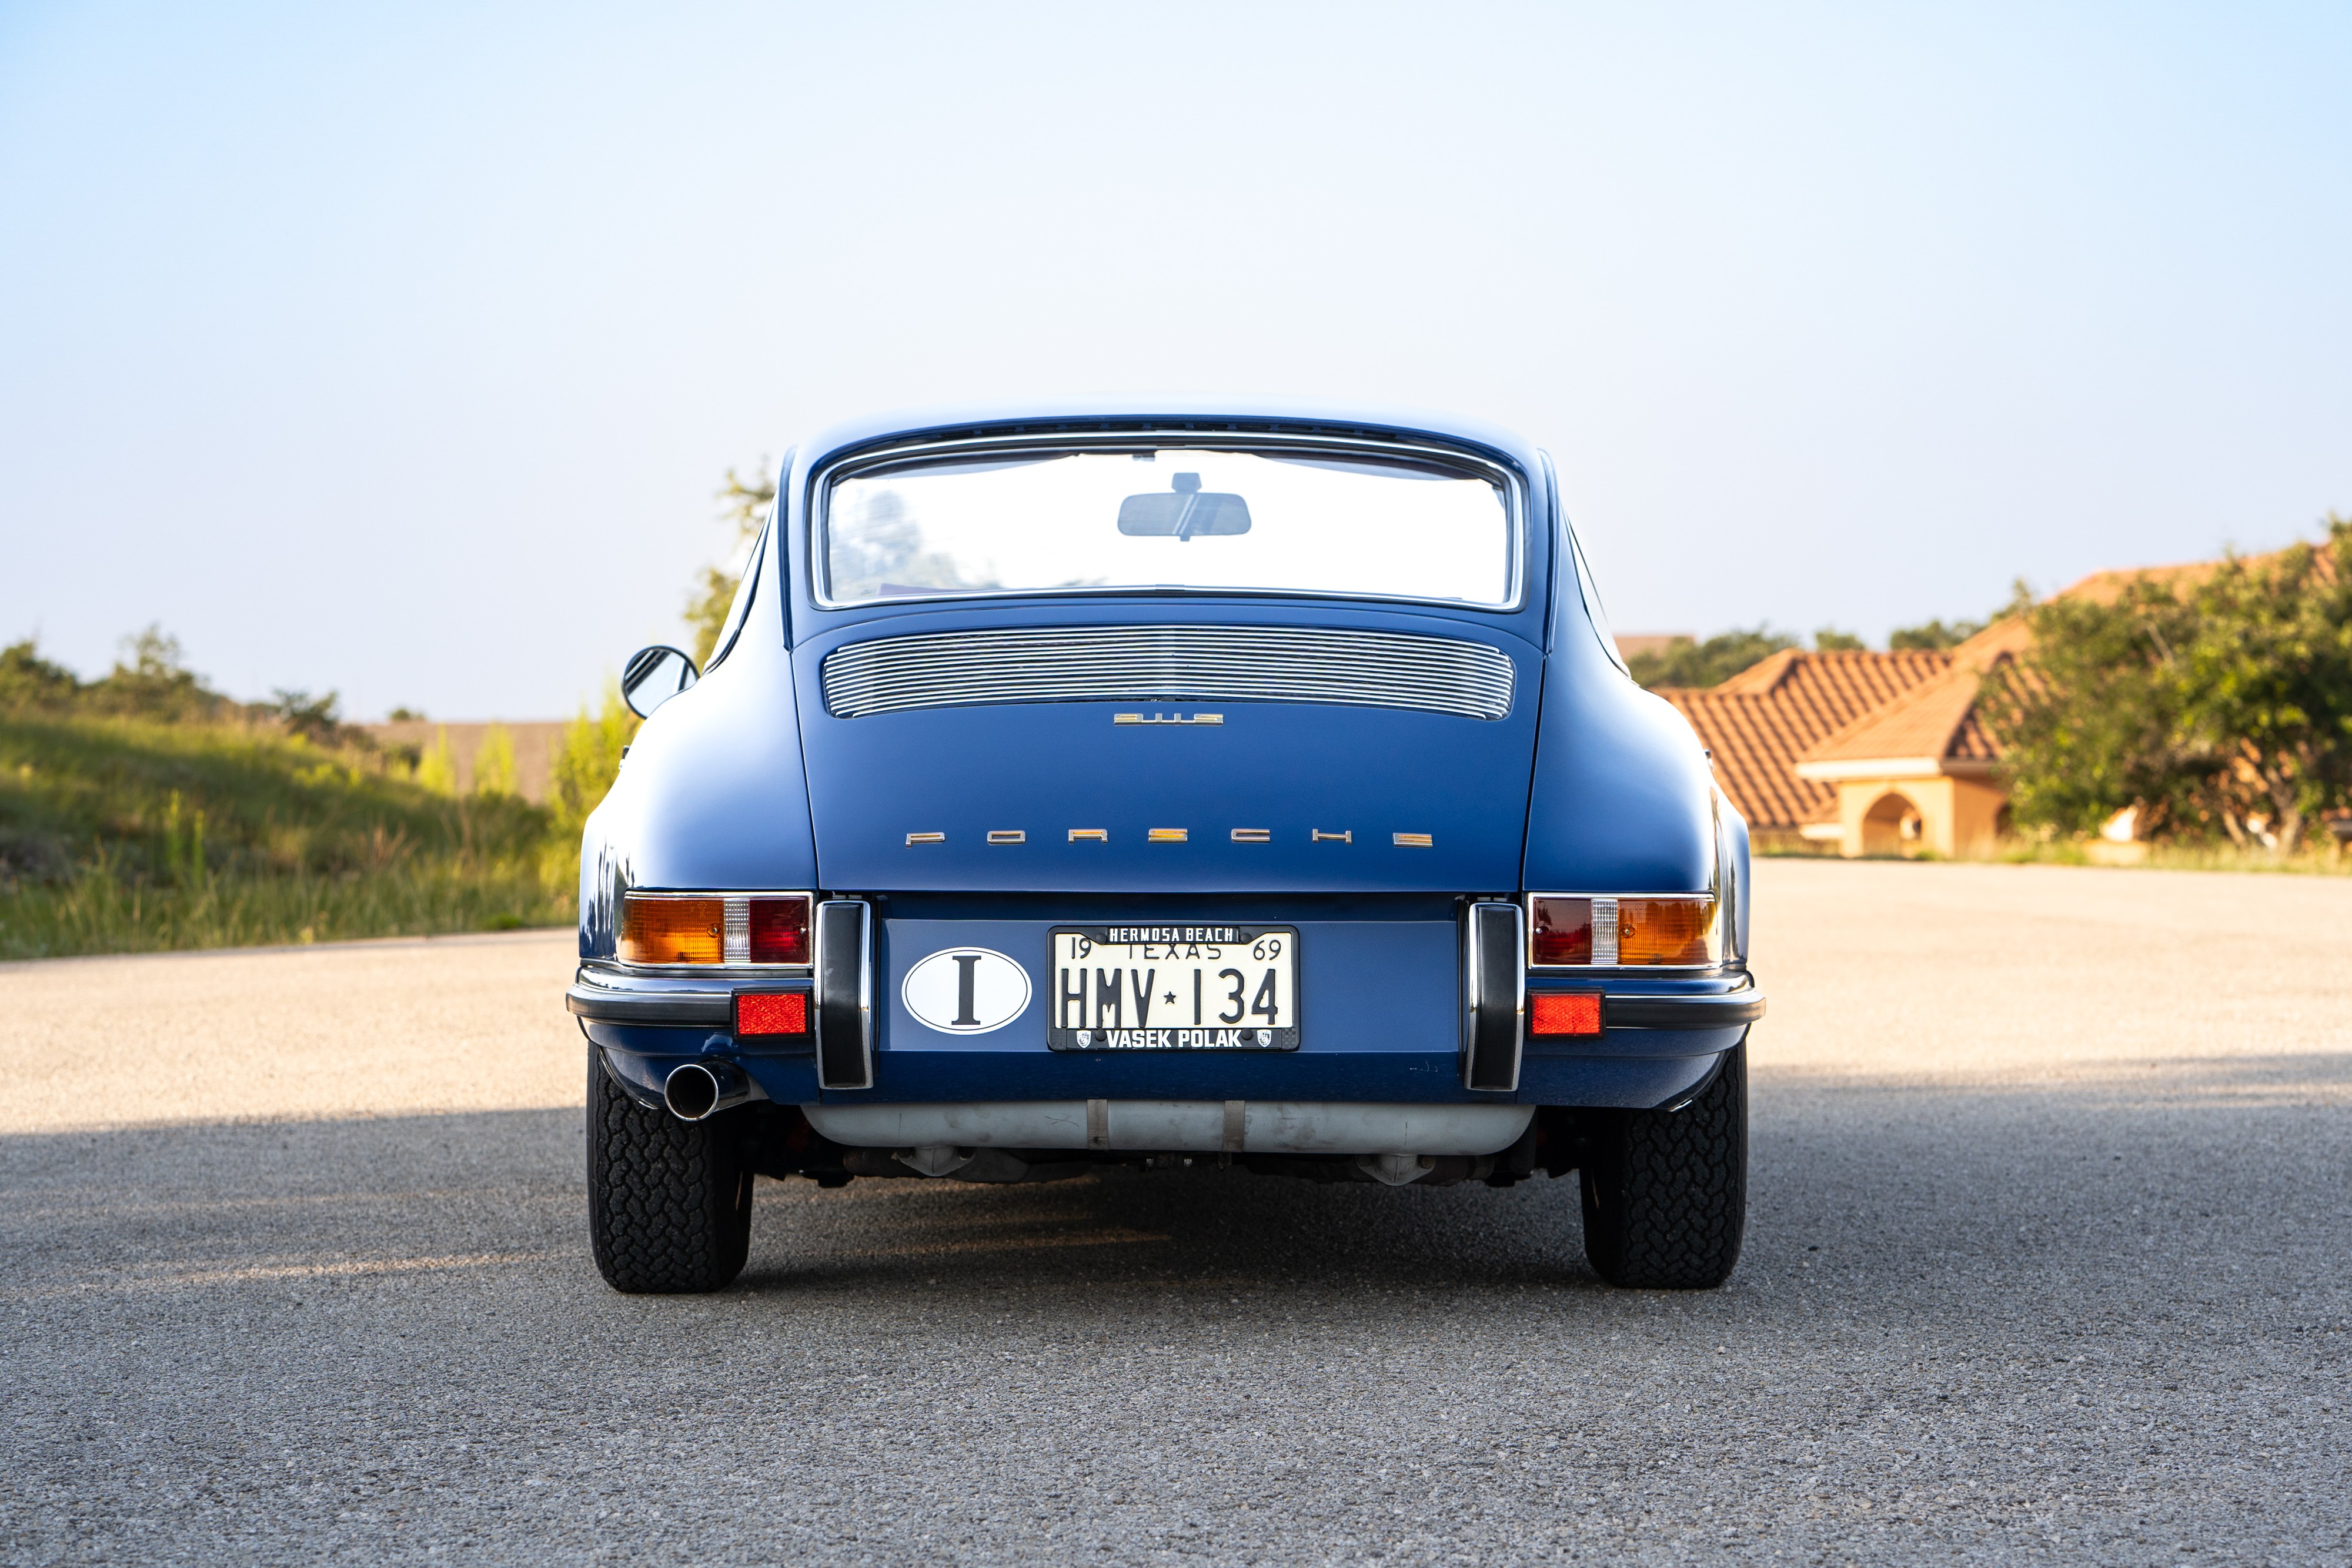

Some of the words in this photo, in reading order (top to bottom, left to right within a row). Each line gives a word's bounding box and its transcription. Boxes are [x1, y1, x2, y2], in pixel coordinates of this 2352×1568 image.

[906, 828, 1433, 847] PORSCHE
[1110, 928, 1180, 942] HERMOSA
[1185, 928, 1233, 942] BEACH
[1071, 937, 1091, 959] 19
[1253, 940, 1281, 961] 69
[951, 955, 981, 1025] I
[1060, 968, 1155, 1028] HMV
[1193, 968, 1278, 1025] 134
[1105, 1029, 1172, 1048] VASEK
[1178, 1029, 1242, 1048] POLAK
